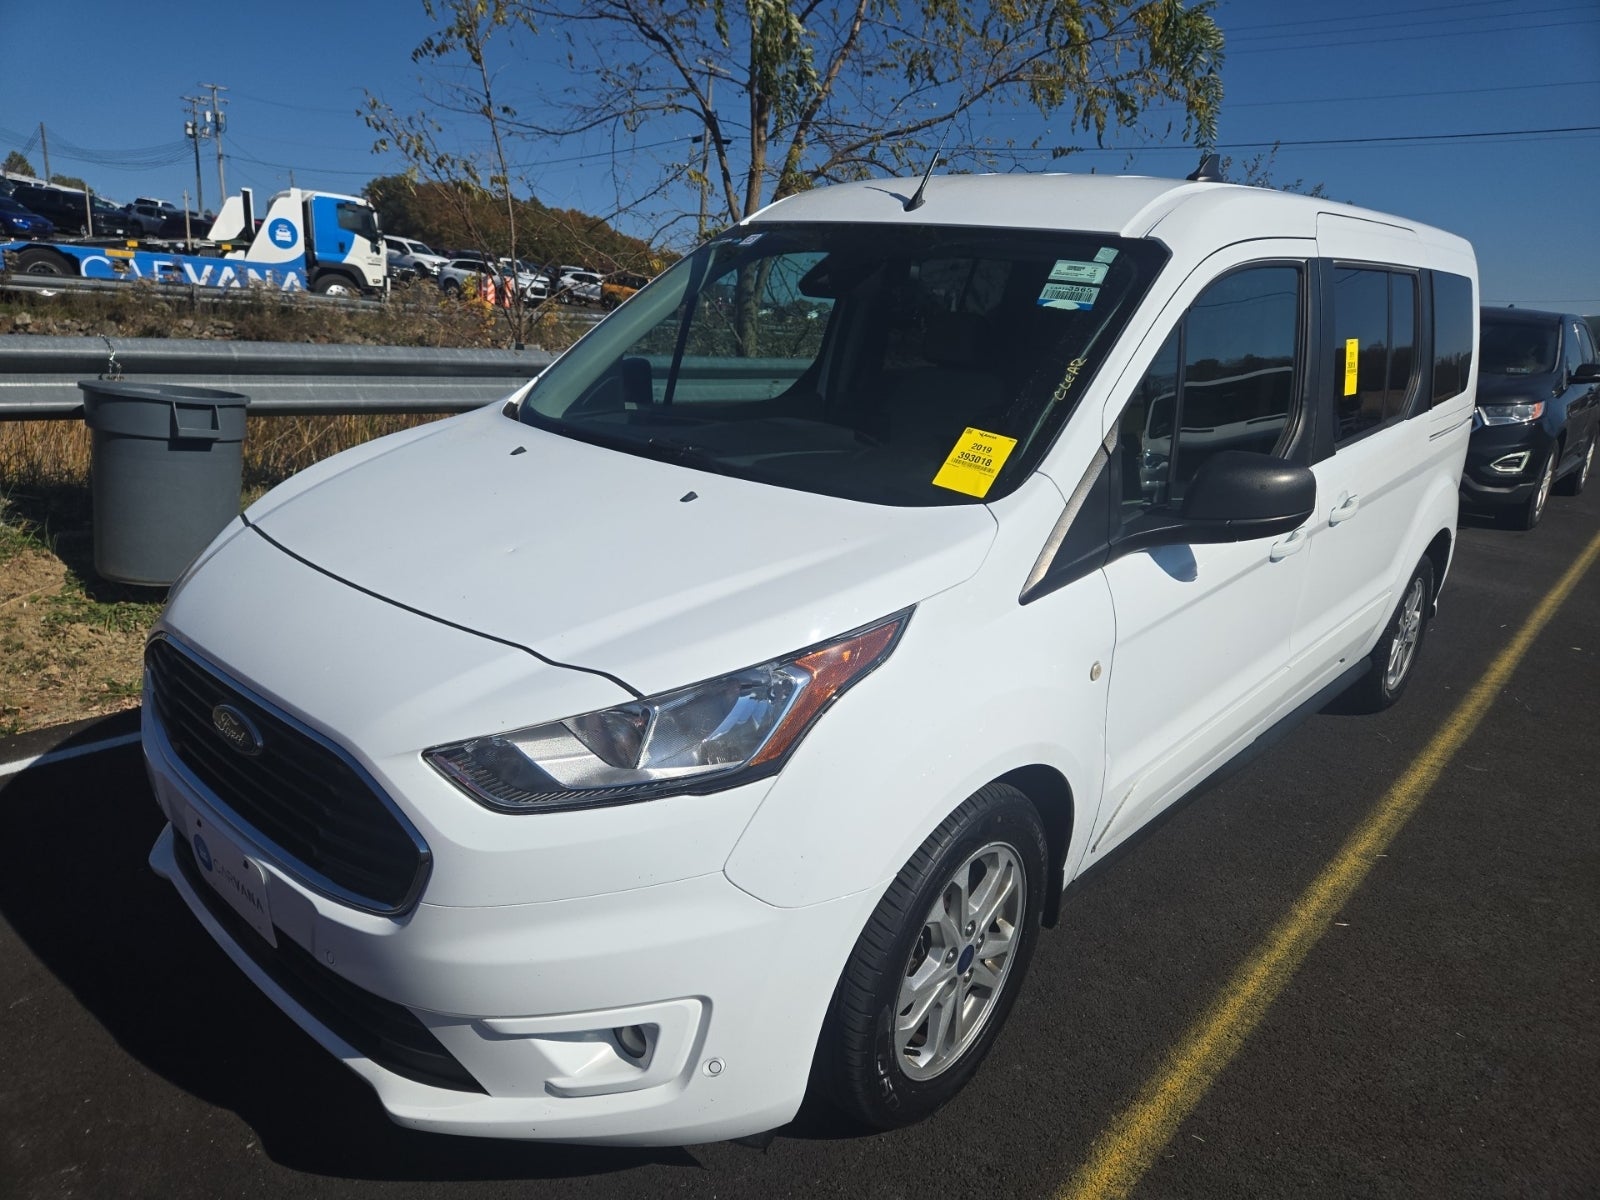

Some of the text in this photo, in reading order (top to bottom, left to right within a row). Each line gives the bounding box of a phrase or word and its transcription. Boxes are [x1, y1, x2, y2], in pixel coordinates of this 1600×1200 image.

[971, 442, 993, 454] 2019
[957, 451, 993, 467] 393018
[214, 712, 246, 745] Ford
